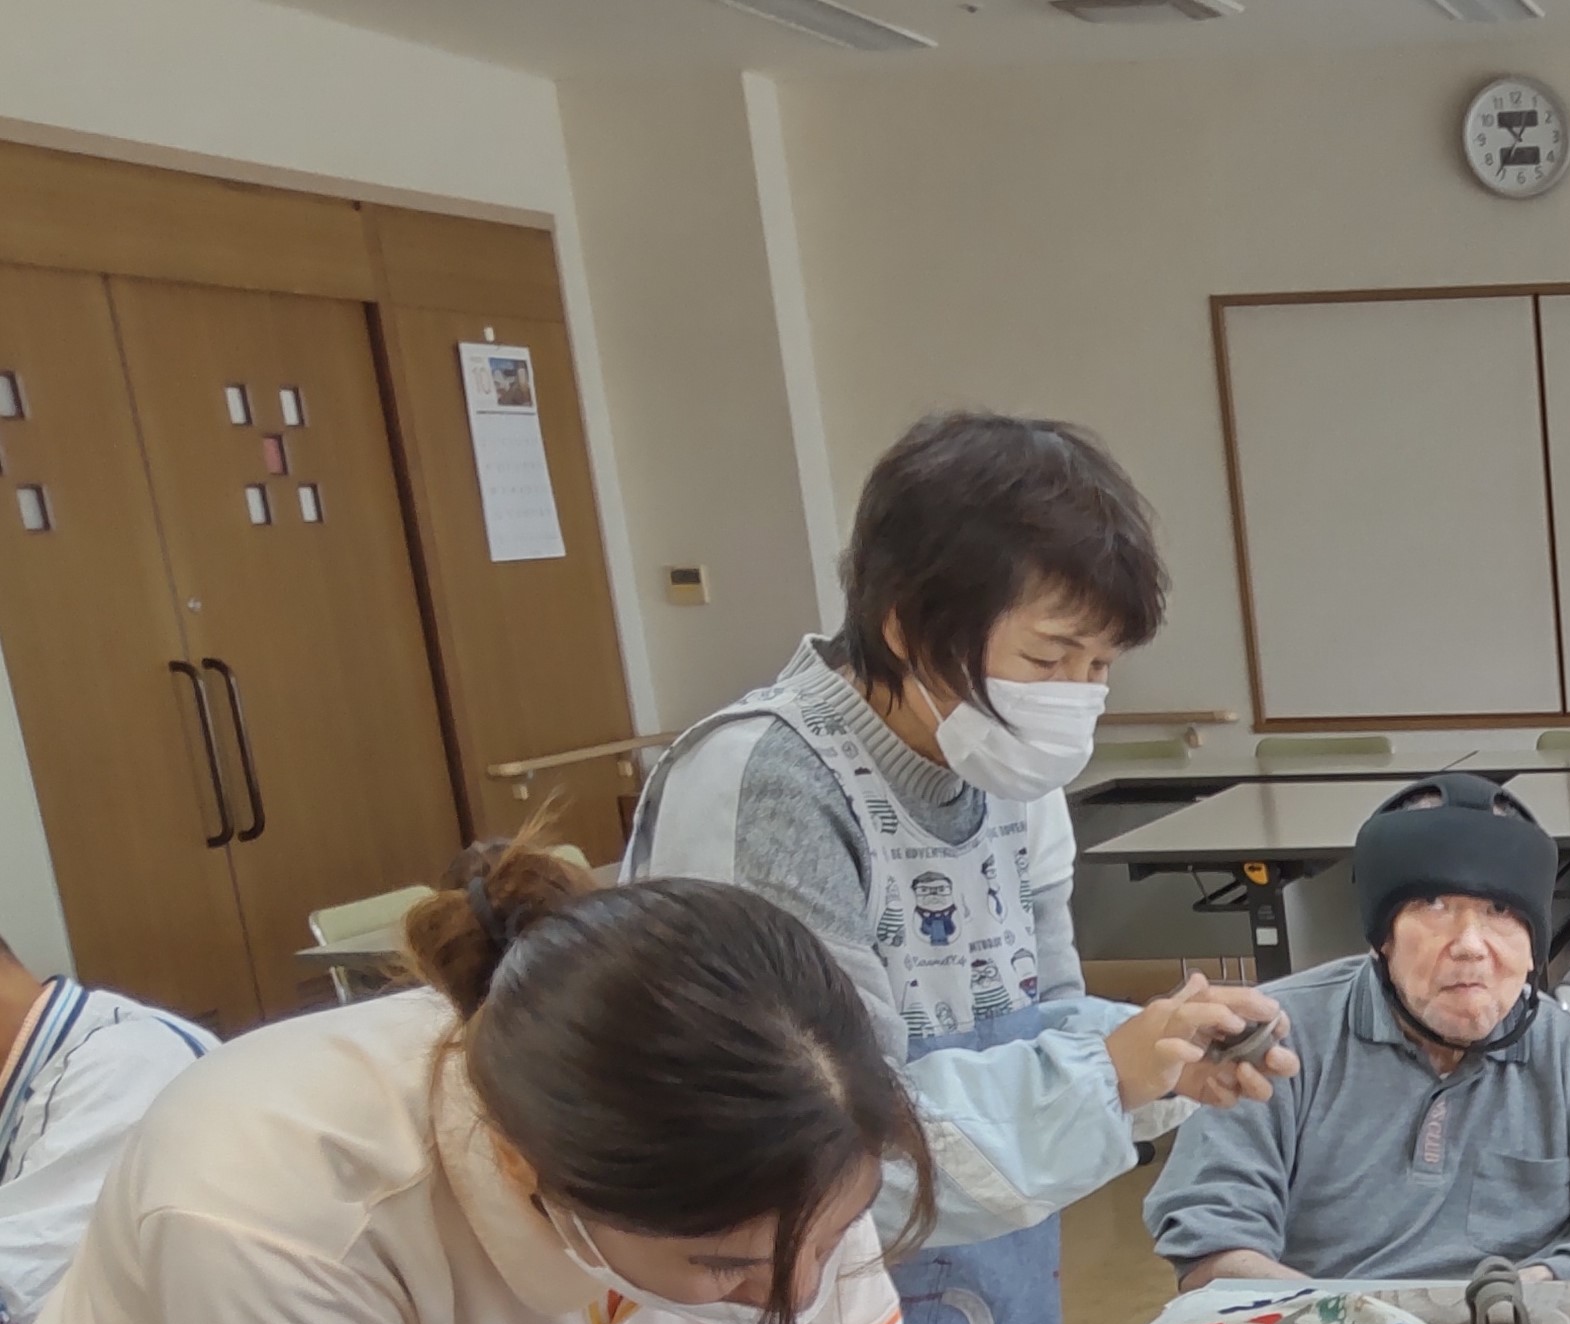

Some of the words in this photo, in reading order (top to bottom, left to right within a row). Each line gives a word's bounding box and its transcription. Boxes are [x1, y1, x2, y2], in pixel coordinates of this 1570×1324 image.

[1493, 96, 1503, 110] 11
[1509, 91, 1522, 105] 12
[1482, 114, 1494, 127] 10
[1544, 112, 1552, 124] 2
[1476, 133, 1487, 147] 9
[1552, 130, 1560, 143] 3
[1484, 153, 1494, 166] 8
[1546, 149, 1555, 163] 4
[1516, 171, 1526, 185] 6
[1535, 165, 1545, 180] 5
